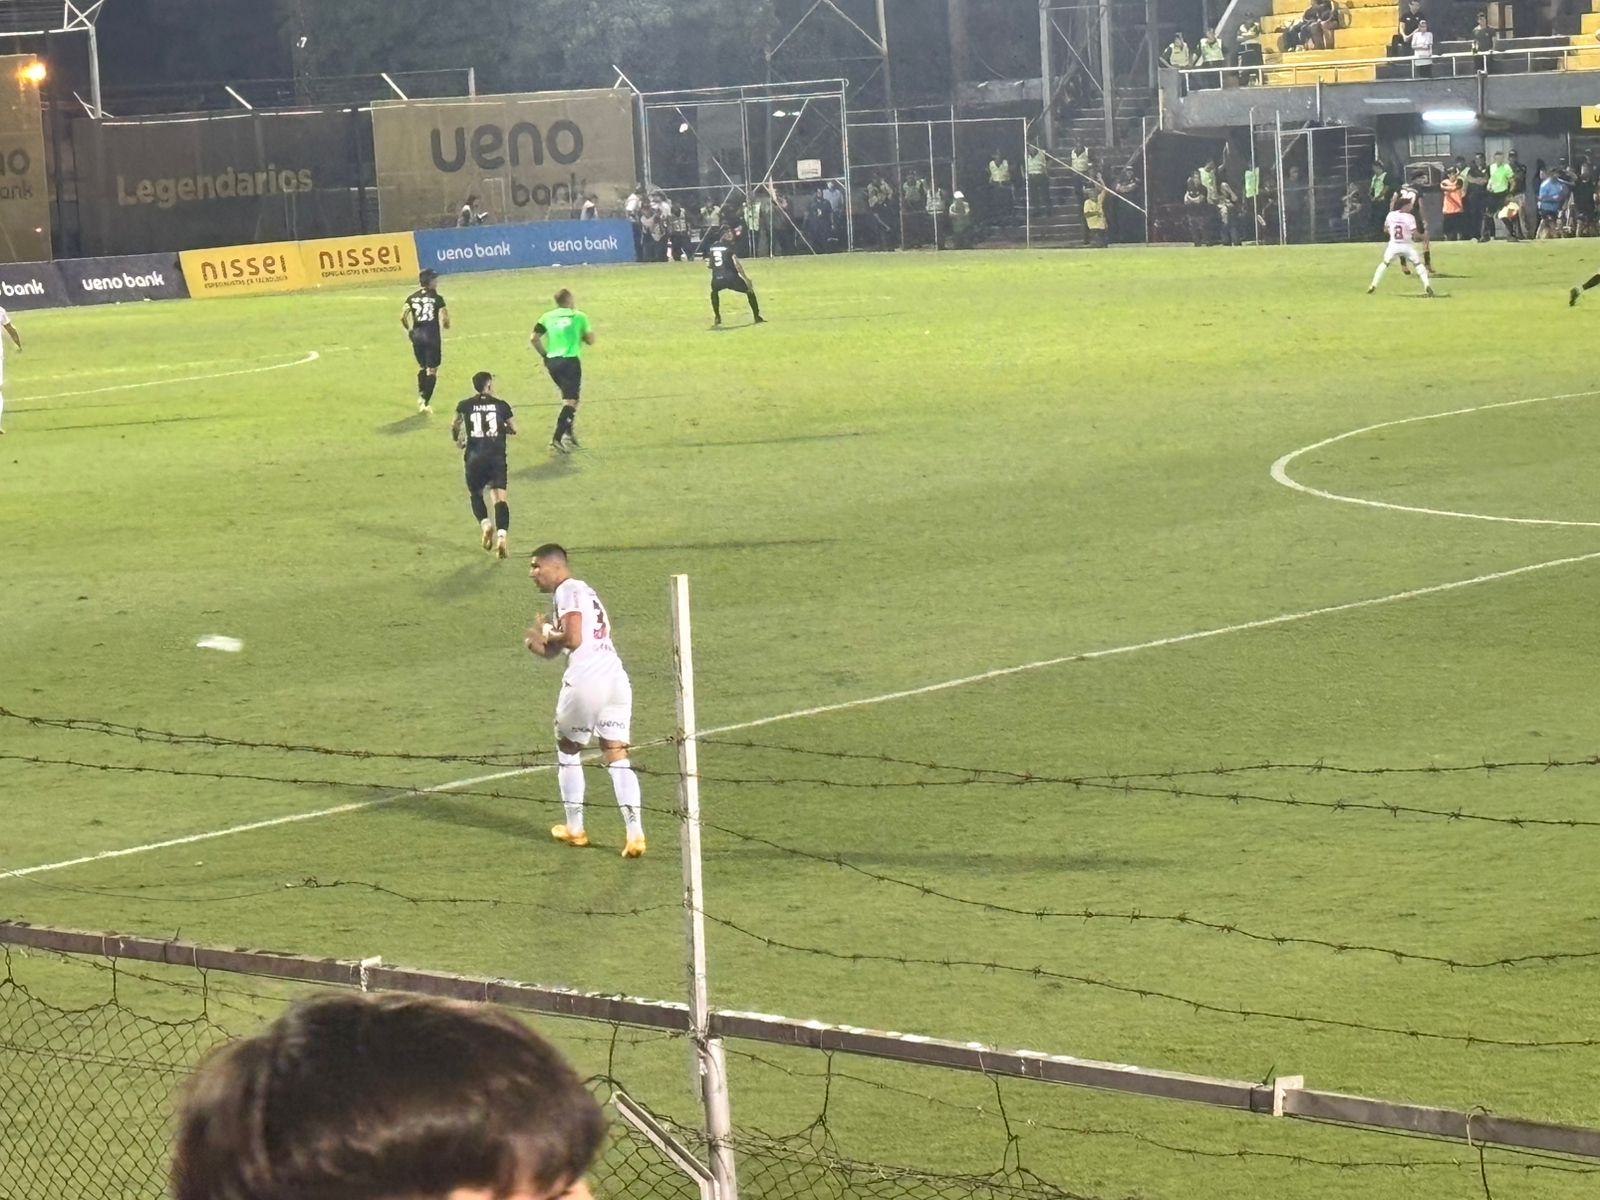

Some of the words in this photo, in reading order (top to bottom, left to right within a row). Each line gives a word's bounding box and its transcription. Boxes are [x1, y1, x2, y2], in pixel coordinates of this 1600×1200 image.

[430, 119, 585, 173] ueno
[116, 163, 313, 209] Legendarios
[511, 172, 587, 207] bank
[437, 248, 473, 262] ueno
[475, 241, 511, 258] bank
[548, 240, 583, 252] ueno
[584, 235, 618, 250] bank
[2, 278, 45, 297] bank
[82, 276, 123, 291] ueno
[122, 270, 165, 288] bank
[469, 411, 499, 438] 11
[592, 599, 607, 640] 3
